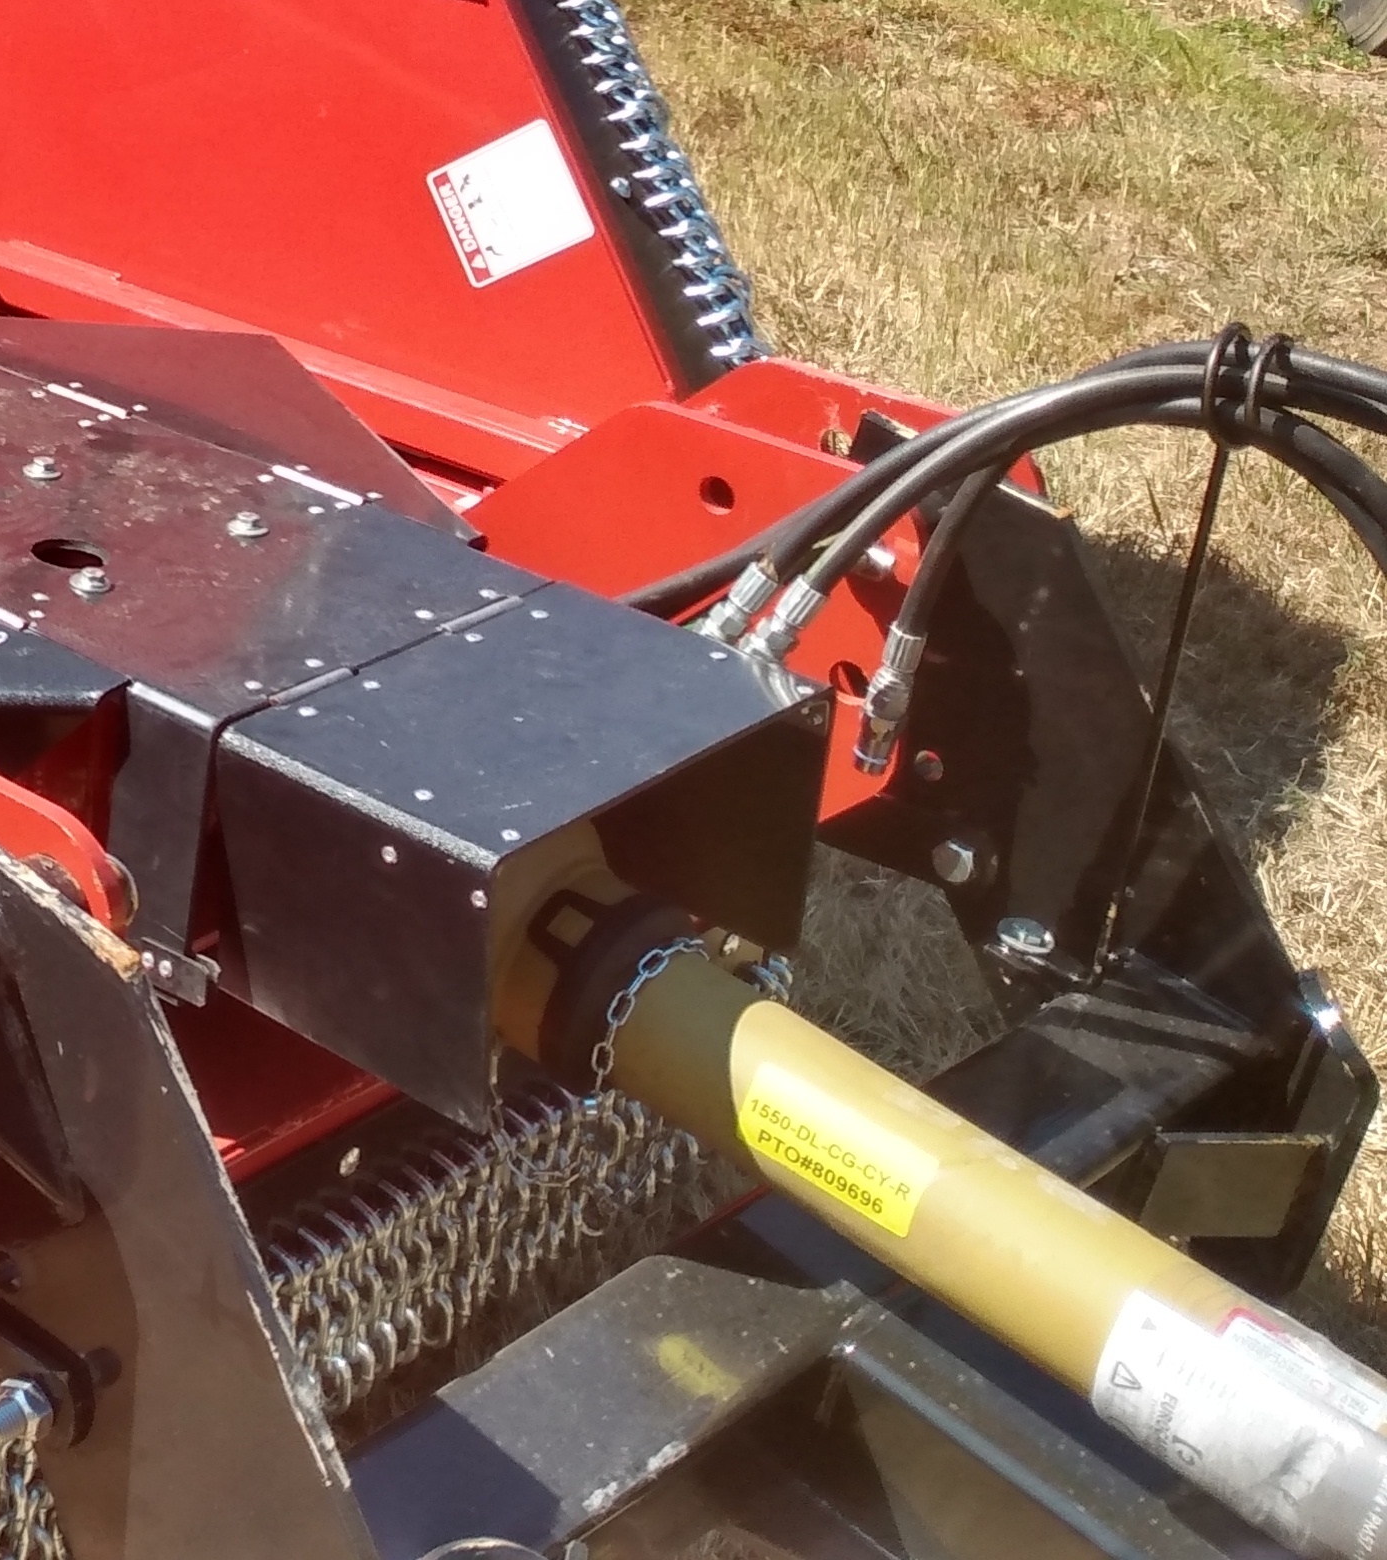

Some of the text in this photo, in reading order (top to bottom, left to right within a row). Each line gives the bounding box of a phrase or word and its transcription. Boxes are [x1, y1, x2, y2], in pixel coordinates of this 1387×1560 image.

[438, 182, 478, 253] DANGER
[750, 1098, 911, 1201] 1550-DL-CG-CY-R
[757, 1129, 884, 1214] PTO#809696
